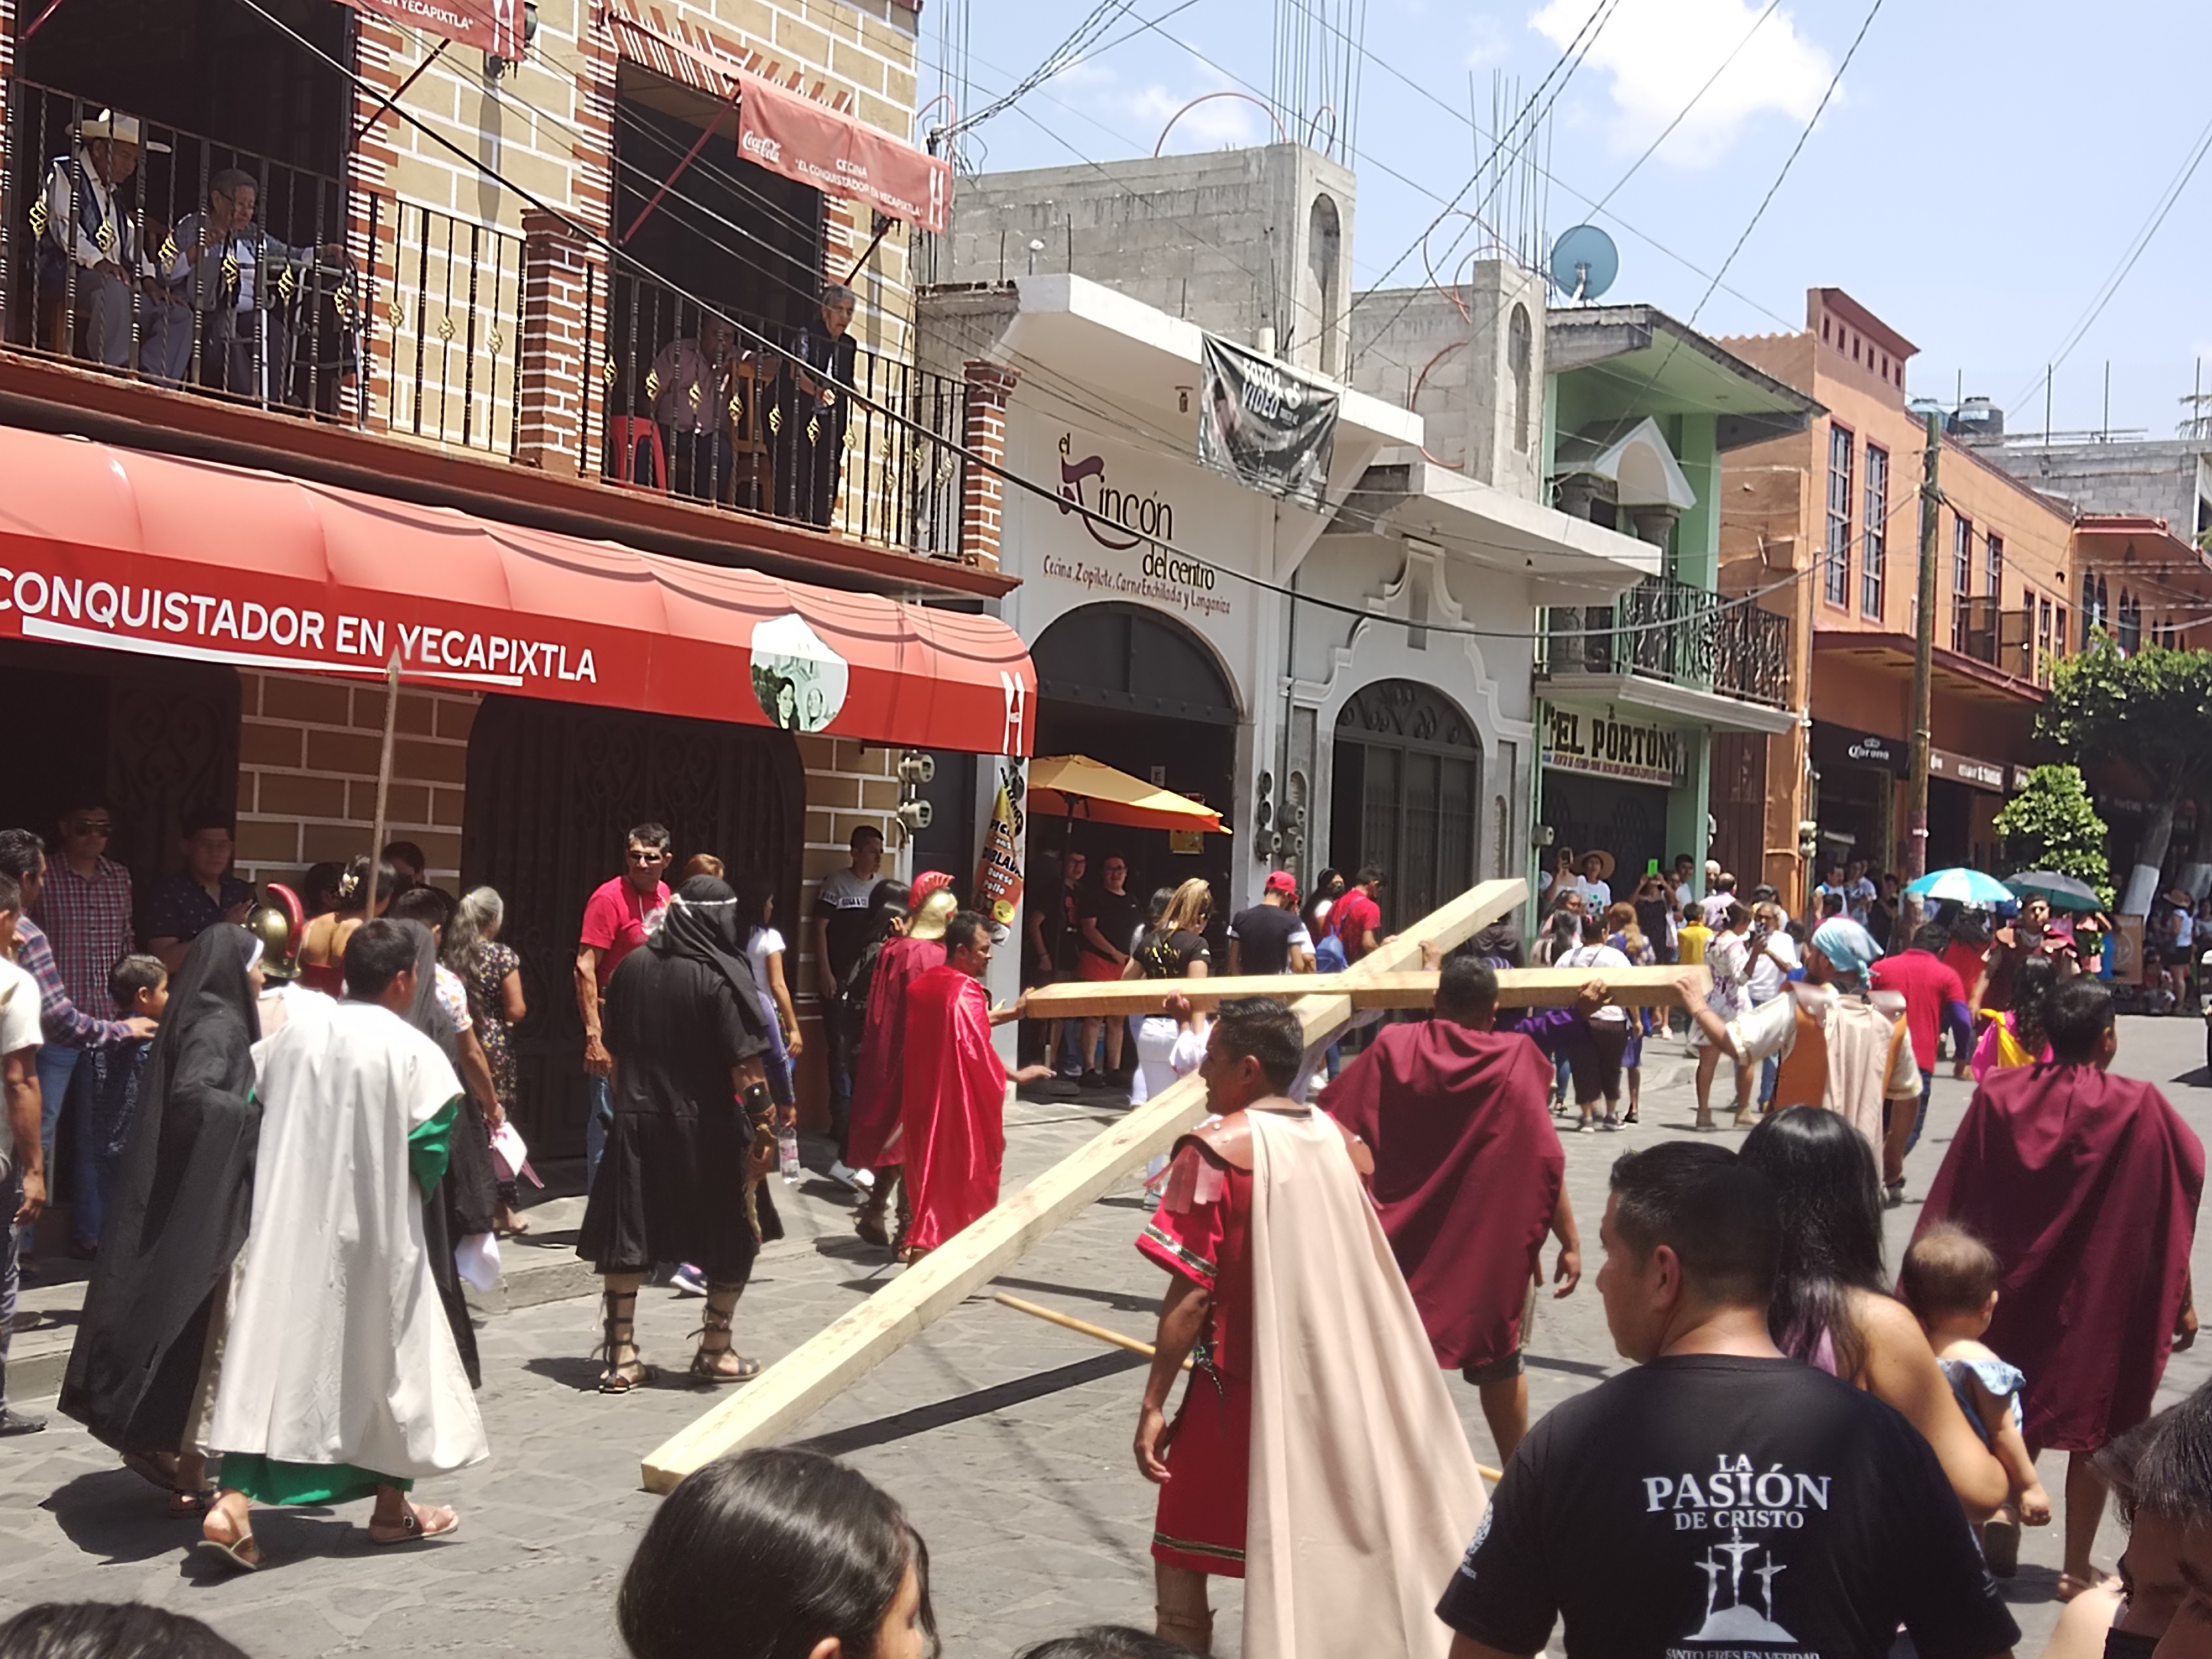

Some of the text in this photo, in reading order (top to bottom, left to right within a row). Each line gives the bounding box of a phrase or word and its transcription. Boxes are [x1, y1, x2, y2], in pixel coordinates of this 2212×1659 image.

[836, 159, 868, 179] CECINA
[810, 164, 870, 192] CONQUISTADOR
[870, 187, 879, 199] EN
[1241, 382, 1280, 420] VIDEO
[1058, 432, 1071, 455] el
[1184, 592, 1190, 611] y
[336, 615, 384, 657] EN
[397, 623, 597, 684] YECAPIXTLA
[1848, 744, 1890, 760] Corona
[1717, 1454, 1754, 1472] LA
[1642, 1463, 1832, 1512] PASIÓN
[1674, 1510, 1804, 1530] DE CRISTO
